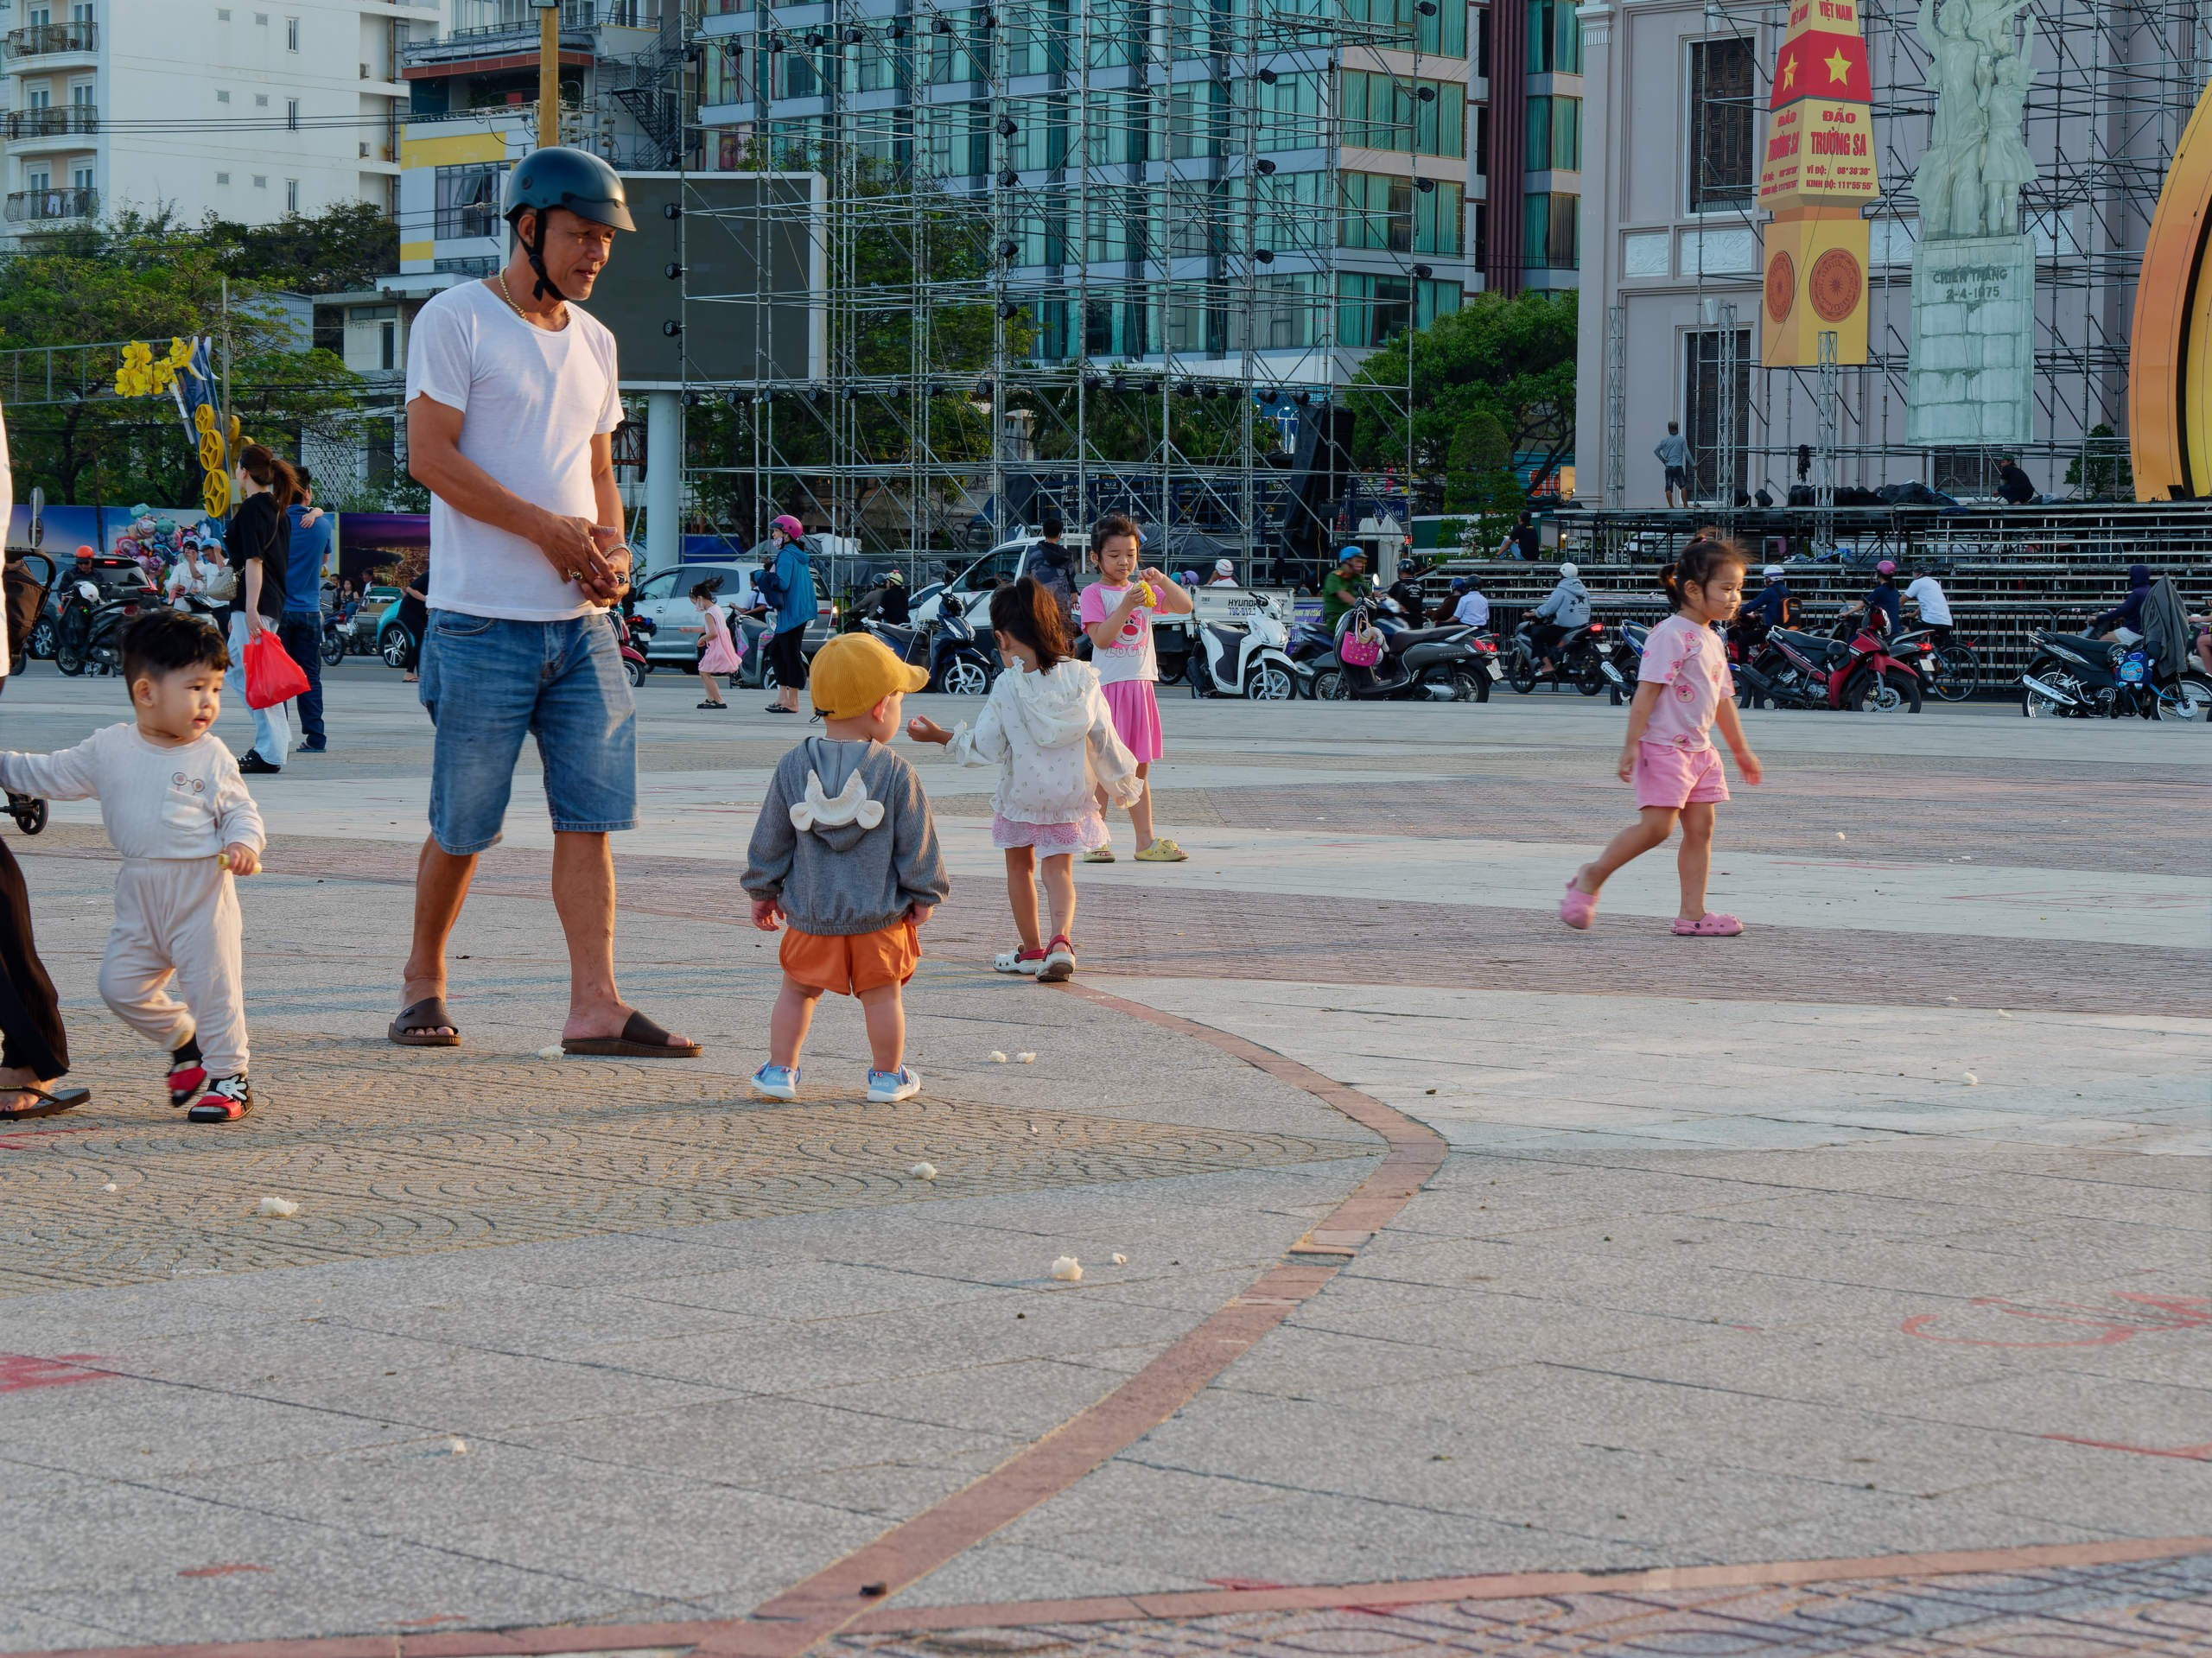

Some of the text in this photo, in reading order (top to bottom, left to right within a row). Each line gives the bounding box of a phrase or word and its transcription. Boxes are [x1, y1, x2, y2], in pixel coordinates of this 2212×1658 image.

[1835, 3, 1853, 22] NAM
[1822, 107, 1856, 124] ĐẢO
[1811, 126, 1867, 156] TRƯỜNG SA
